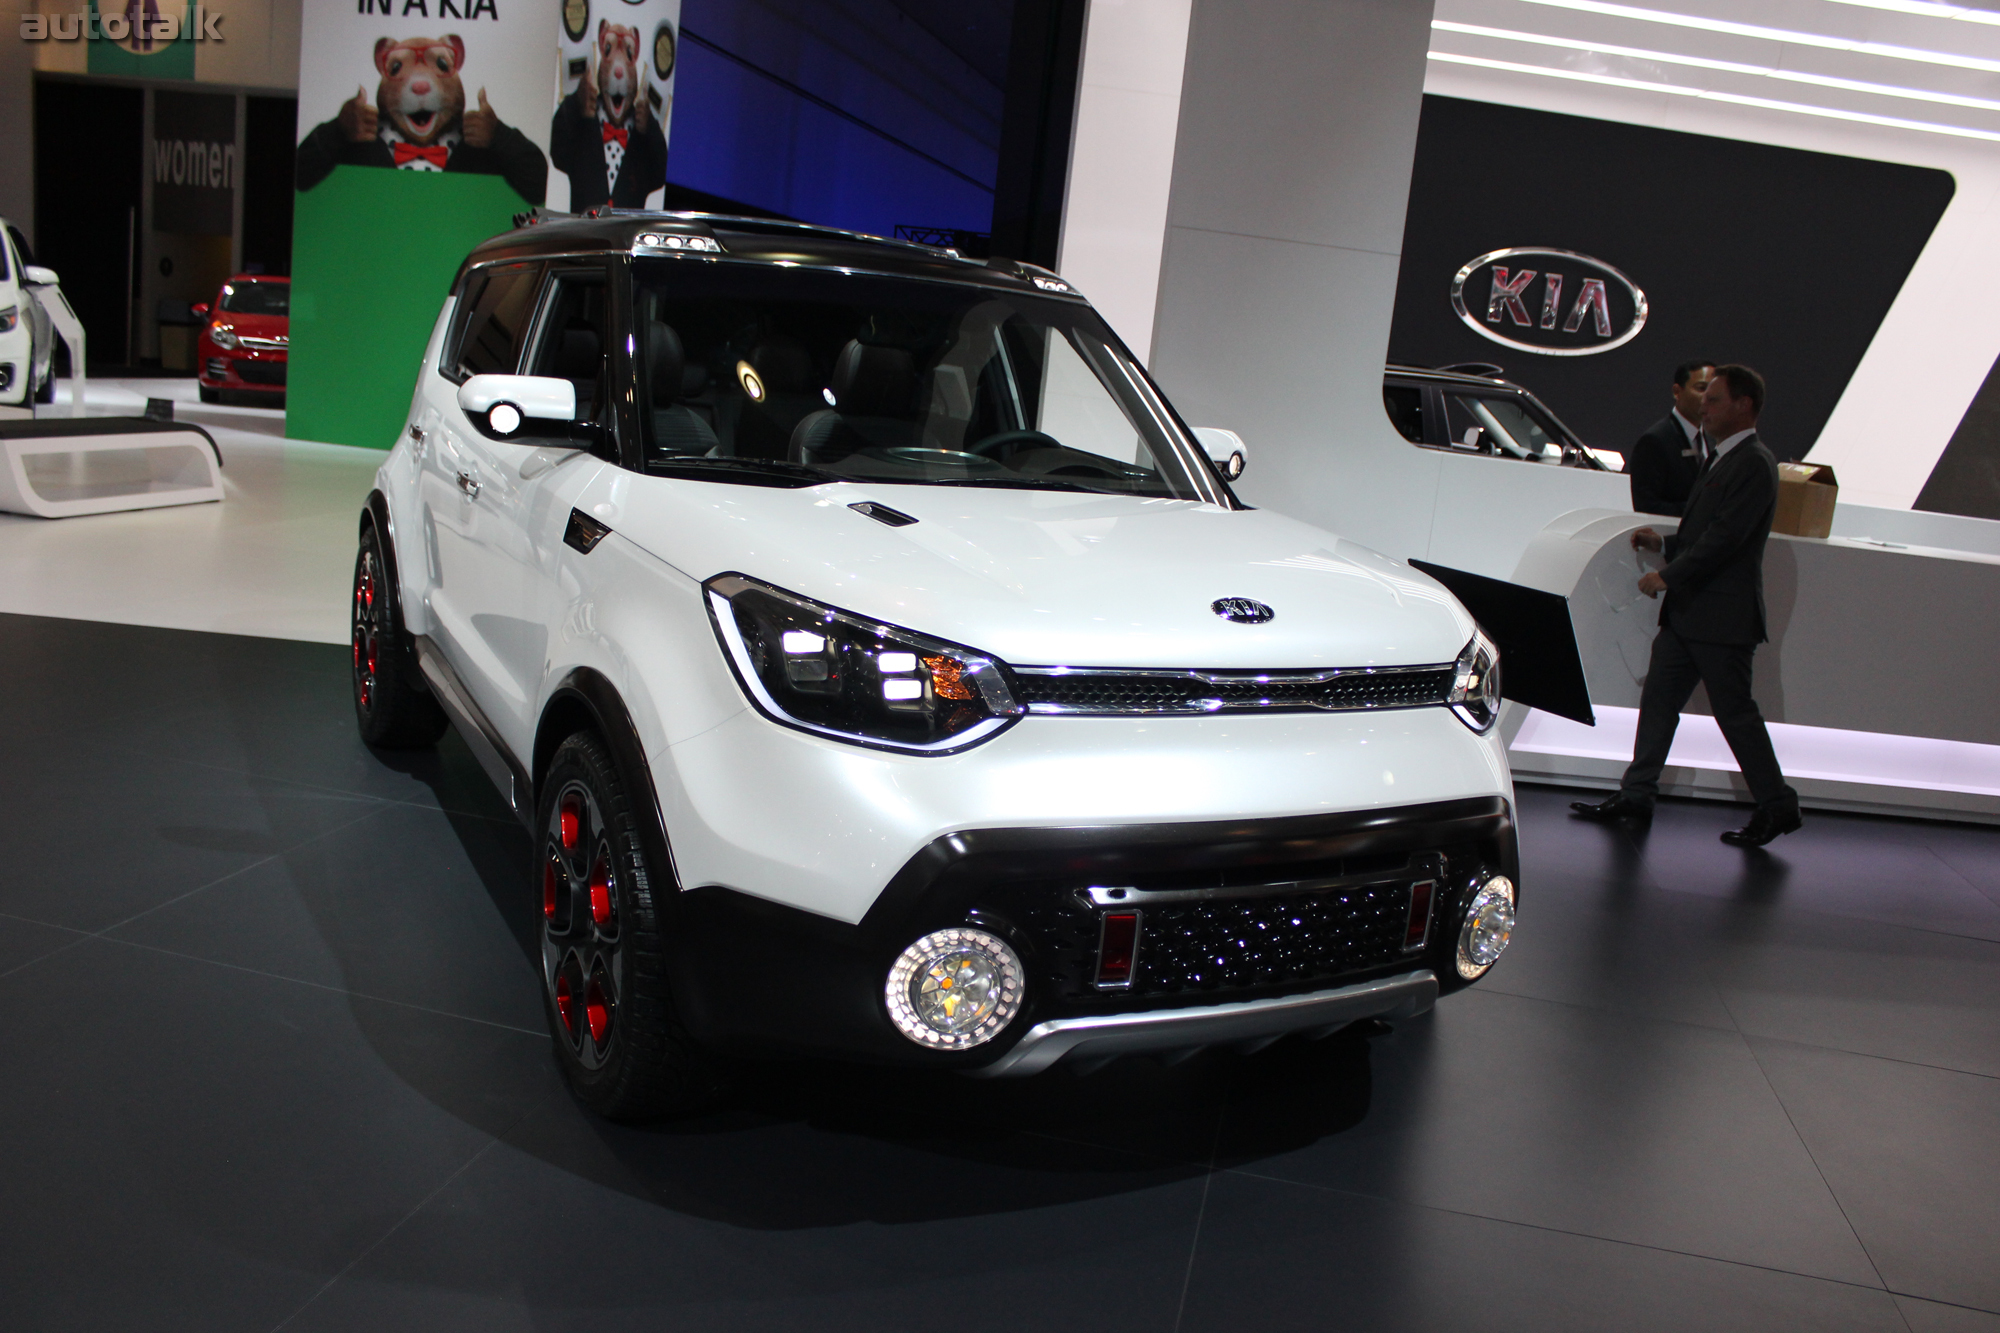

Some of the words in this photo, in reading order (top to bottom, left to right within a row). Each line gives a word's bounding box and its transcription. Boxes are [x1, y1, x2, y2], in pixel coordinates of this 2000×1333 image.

[358, 0, 391, 15] IN
[402, 0, 429, 18] A
[439, 0, 499, 21] KIA
[154, 140, 236, 188] women
[1486, 265, 1613, 338] KIA
[1220, 600, 1270, 616] KIA
